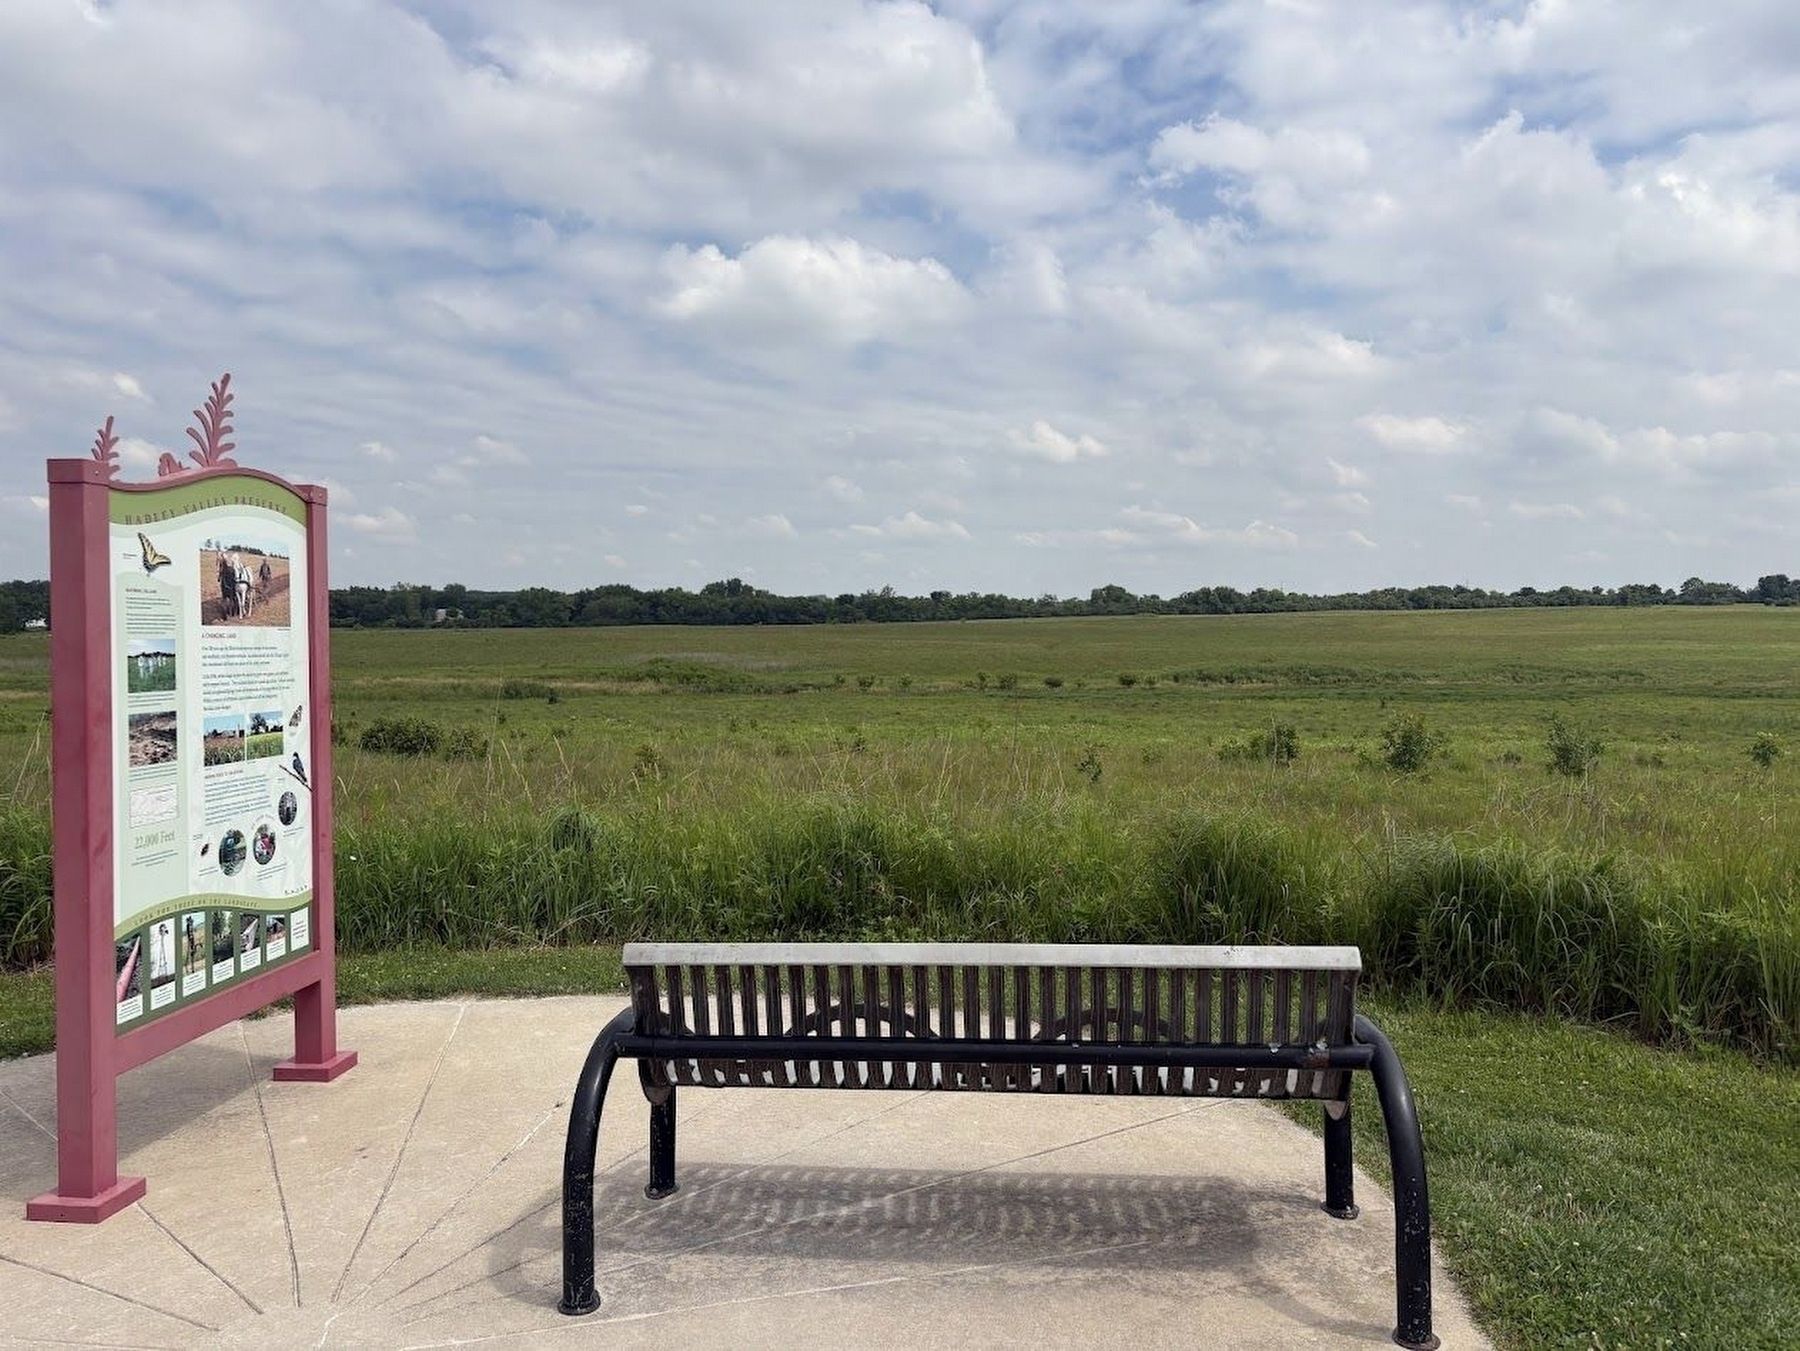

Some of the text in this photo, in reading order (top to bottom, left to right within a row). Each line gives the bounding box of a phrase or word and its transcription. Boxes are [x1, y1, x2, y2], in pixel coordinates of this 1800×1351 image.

[125, 496, 286, 525] HADLEY VALLEY PRESERVE
